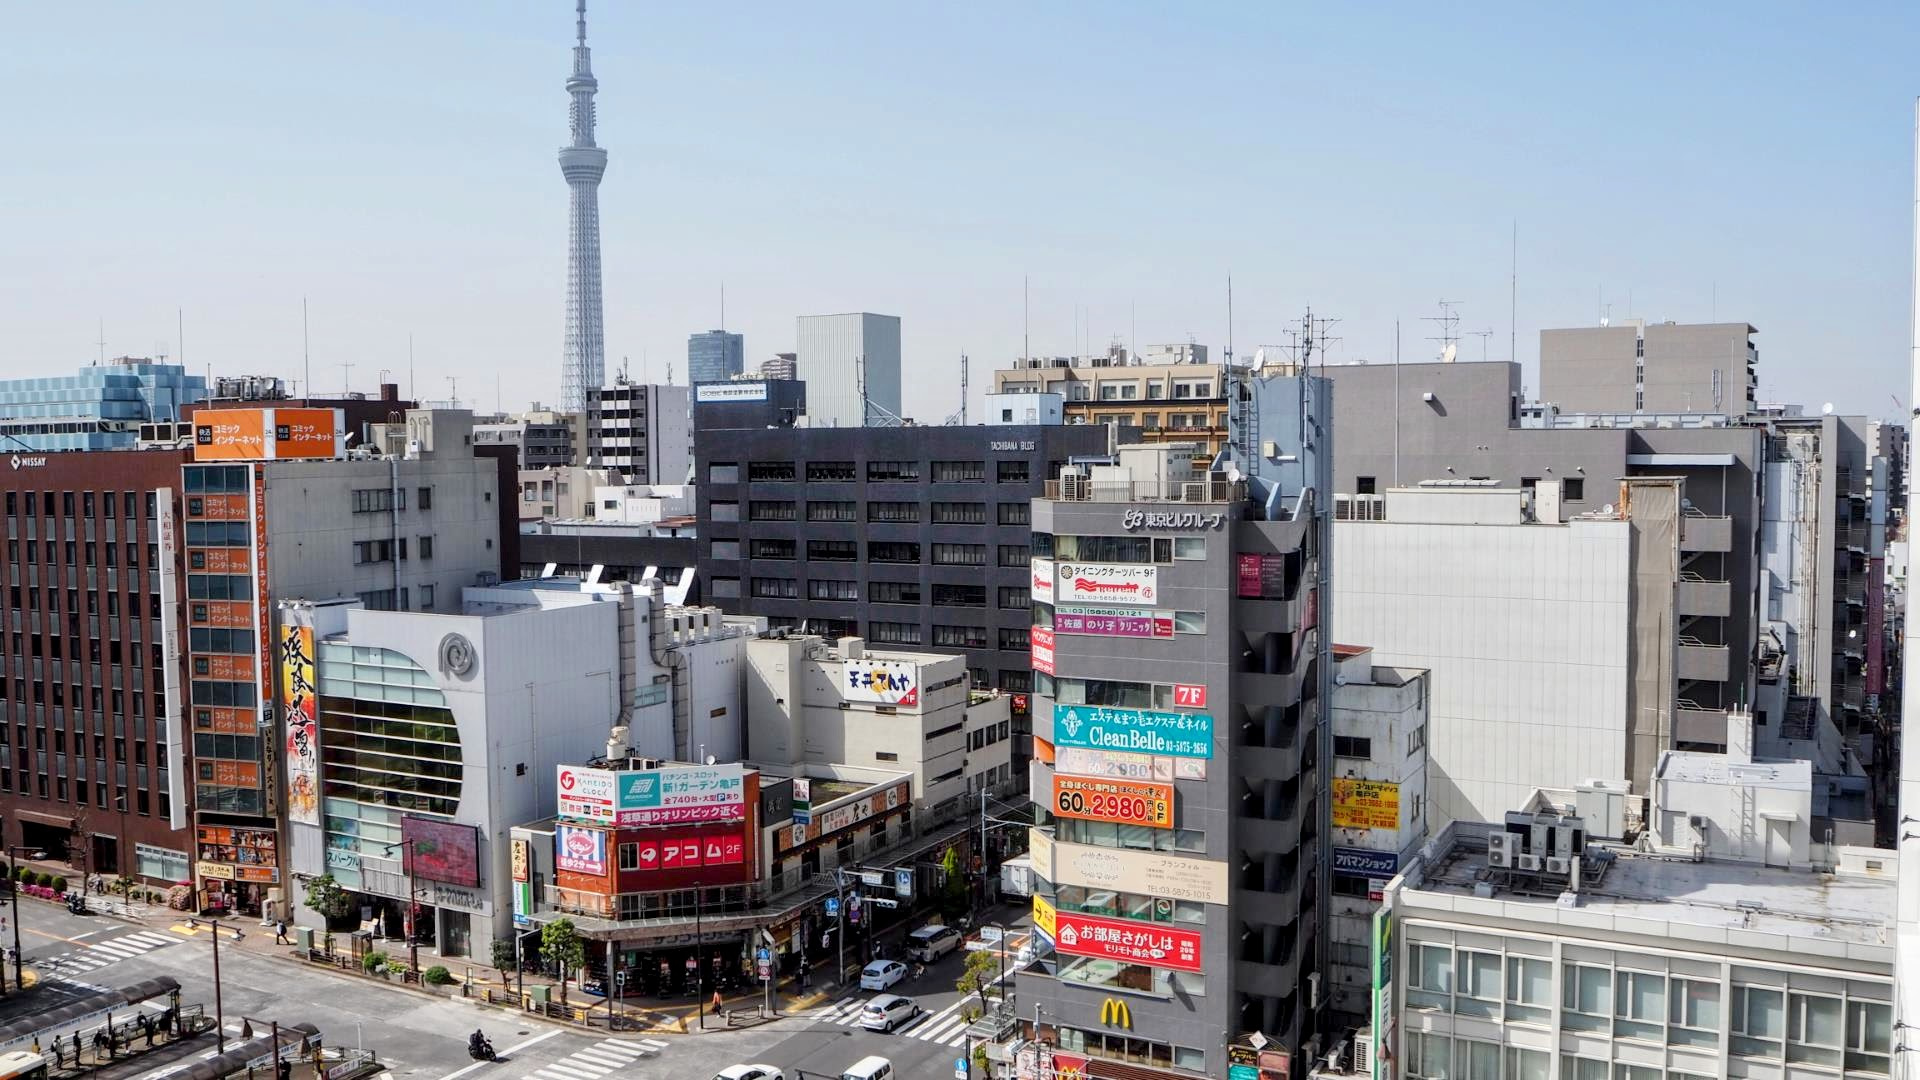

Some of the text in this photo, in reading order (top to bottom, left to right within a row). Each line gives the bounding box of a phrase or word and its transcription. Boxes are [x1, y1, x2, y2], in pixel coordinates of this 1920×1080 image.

[214, 424, 240, 434] コミック
[214, 436, 261, 446] インターネット
[293, 433, 332, 441] インターネット
[22, 457, 46, 466] NISSAY
[1146, 513, 1222, 528] 東京ビルグループ
[1074, 567, 1155, 578] ダイニングダーツバー 9F
[1087, 620, 1116, 631] のり子
[1120, 621, 1150, 632] クリニック
[906, 694, 916, 703] 1F
[1178, 687, 1201, 703] 7F
[1090, 712, 1208, 731] エステ&まつ毛エクステ&ネイル
[1092, 794, 1146, 820] 2,980
[328, 853, 360, 866] スパークル
[664, 844, 741, 862] アコム 2F
[1336, 854, 1394, 870] アパマンショップ
[1062, 934, 1074, 942] 4F
[1081, 925, 1174, 950] お部屋さがしは
[1104, 944, 1150, 958] モリモト商会
